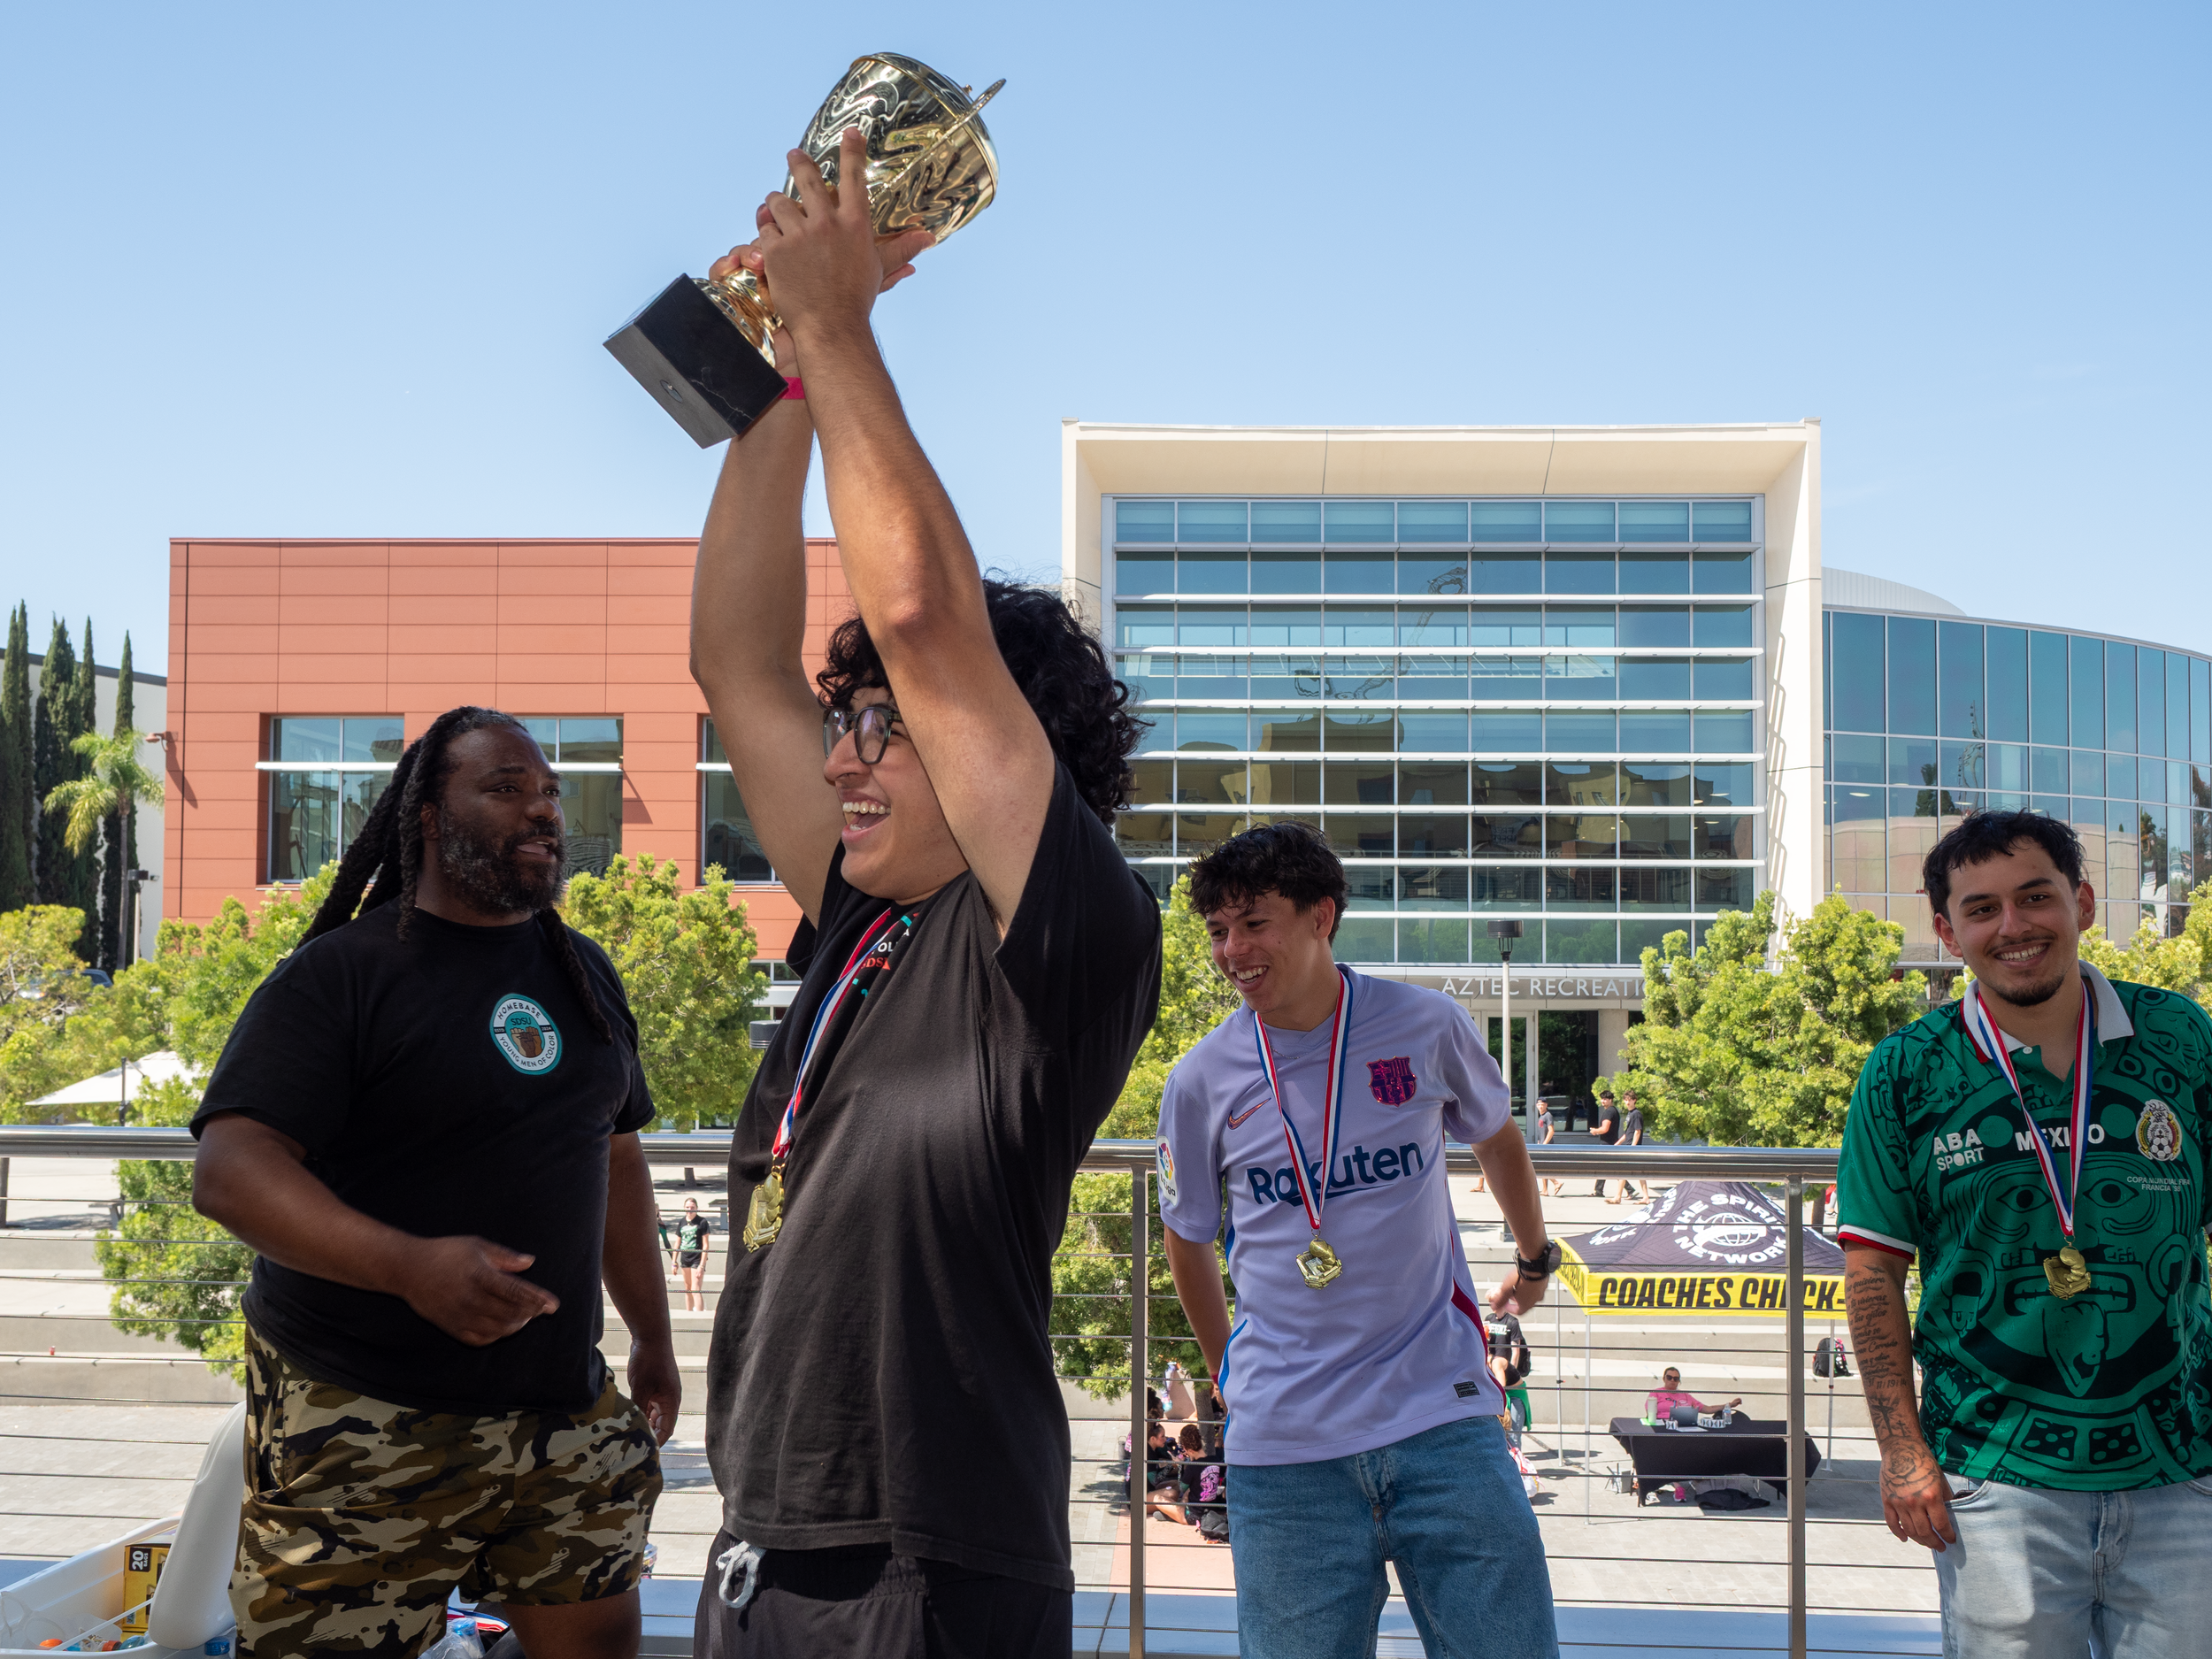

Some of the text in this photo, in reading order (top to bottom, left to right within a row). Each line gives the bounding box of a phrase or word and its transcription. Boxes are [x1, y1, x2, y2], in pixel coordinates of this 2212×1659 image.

[1441, 977, 1646, 996] AZTEC RECREATI
[497, 1002, 541, 1019] HOMEBASE
[511, 1017, 532, 1026] SDSU
[499, 1036, 520, 1063] YOUNG
[545, 1034, 556, 1059] COLOR
[1933, 1128, 1983, 1156] ABA
[2014, 1123, 2106, 1151] MXIO
[1936, 1147, 1985, 1171] SPORT
[1672, 1200, 1709, 1233] THE
[1710, 1194, 1786, 1233] SPIRIT
[1674, 1235, 1787, 1265] NETWORK
[1598, 1277, 1735, 1309] COACHES
[132, 1550, 144, 1571] 20
